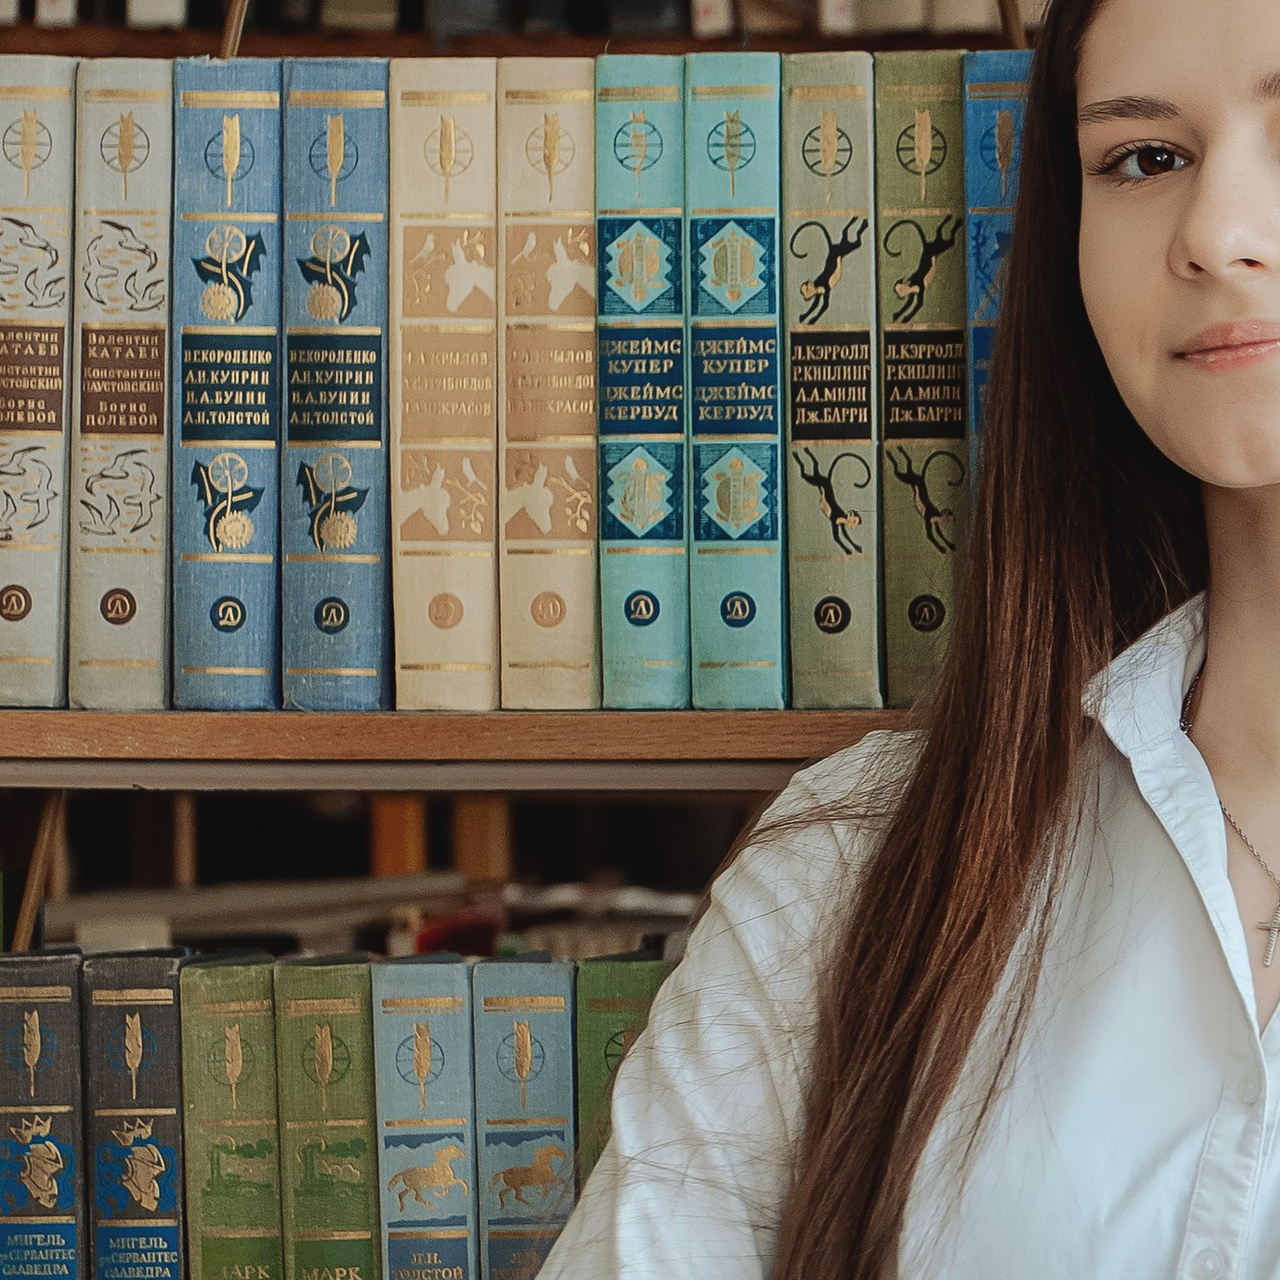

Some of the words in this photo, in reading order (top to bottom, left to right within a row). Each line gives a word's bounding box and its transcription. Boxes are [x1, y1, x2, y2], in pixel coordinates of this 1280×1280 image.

[0, 331, 58, 343] алентин
[0, 343, 59, 356] АТАЕВ
[88, 346, 159, 359] КАТАЕВ
[600, 337, 682, 356] ДЖЕЙМС
[693, 337, 776, 357] ДЖЕЙМС
[791, 343, 870, 361] Л.КЭРРОЛЛ
[608, 359, 674, 374] КУПЕР
[702, 359, 770, 374] КУПЕР
[792, 364, 871, 382] Р.КИПЛИНГ
[601, 382, 683, 402] ДЖЕЙМС
[694, 382, 777, 403] ДЖЕЙМС
[86, 412, 158, 427] ПОЛЕВОЙ
[604, 405, 678, 421] КЕРВУД
[698, 405, 774, 421] КЕРВУД
[109, 1236, 168, 1249] МИГЕЛЬ
[221, 1265, 271, 1280] АРК
